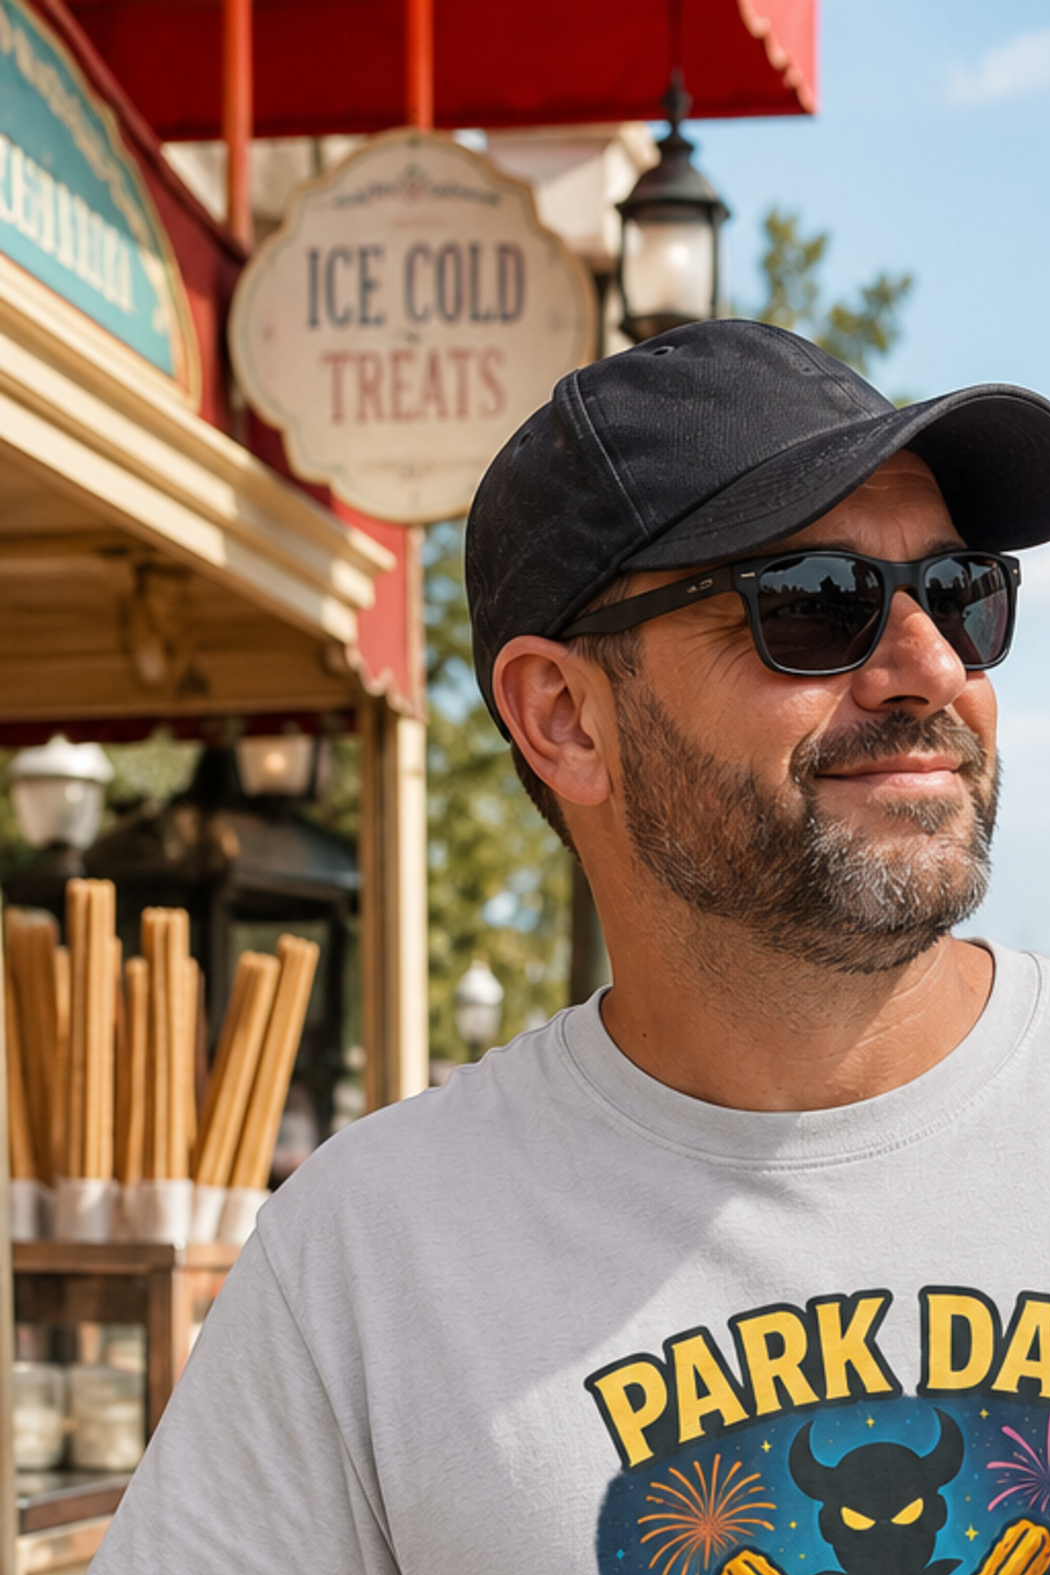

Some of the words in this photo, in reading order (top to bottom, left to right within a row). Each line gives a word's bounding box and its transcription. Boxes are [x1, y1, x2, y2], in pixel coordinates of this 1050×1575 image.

[306, 244, 385, 330] ICE
[403, 239, 526, 326] COLD
[320, 346, 508, 424] TREATS
[585, 1290, 903, 1471] PARK
